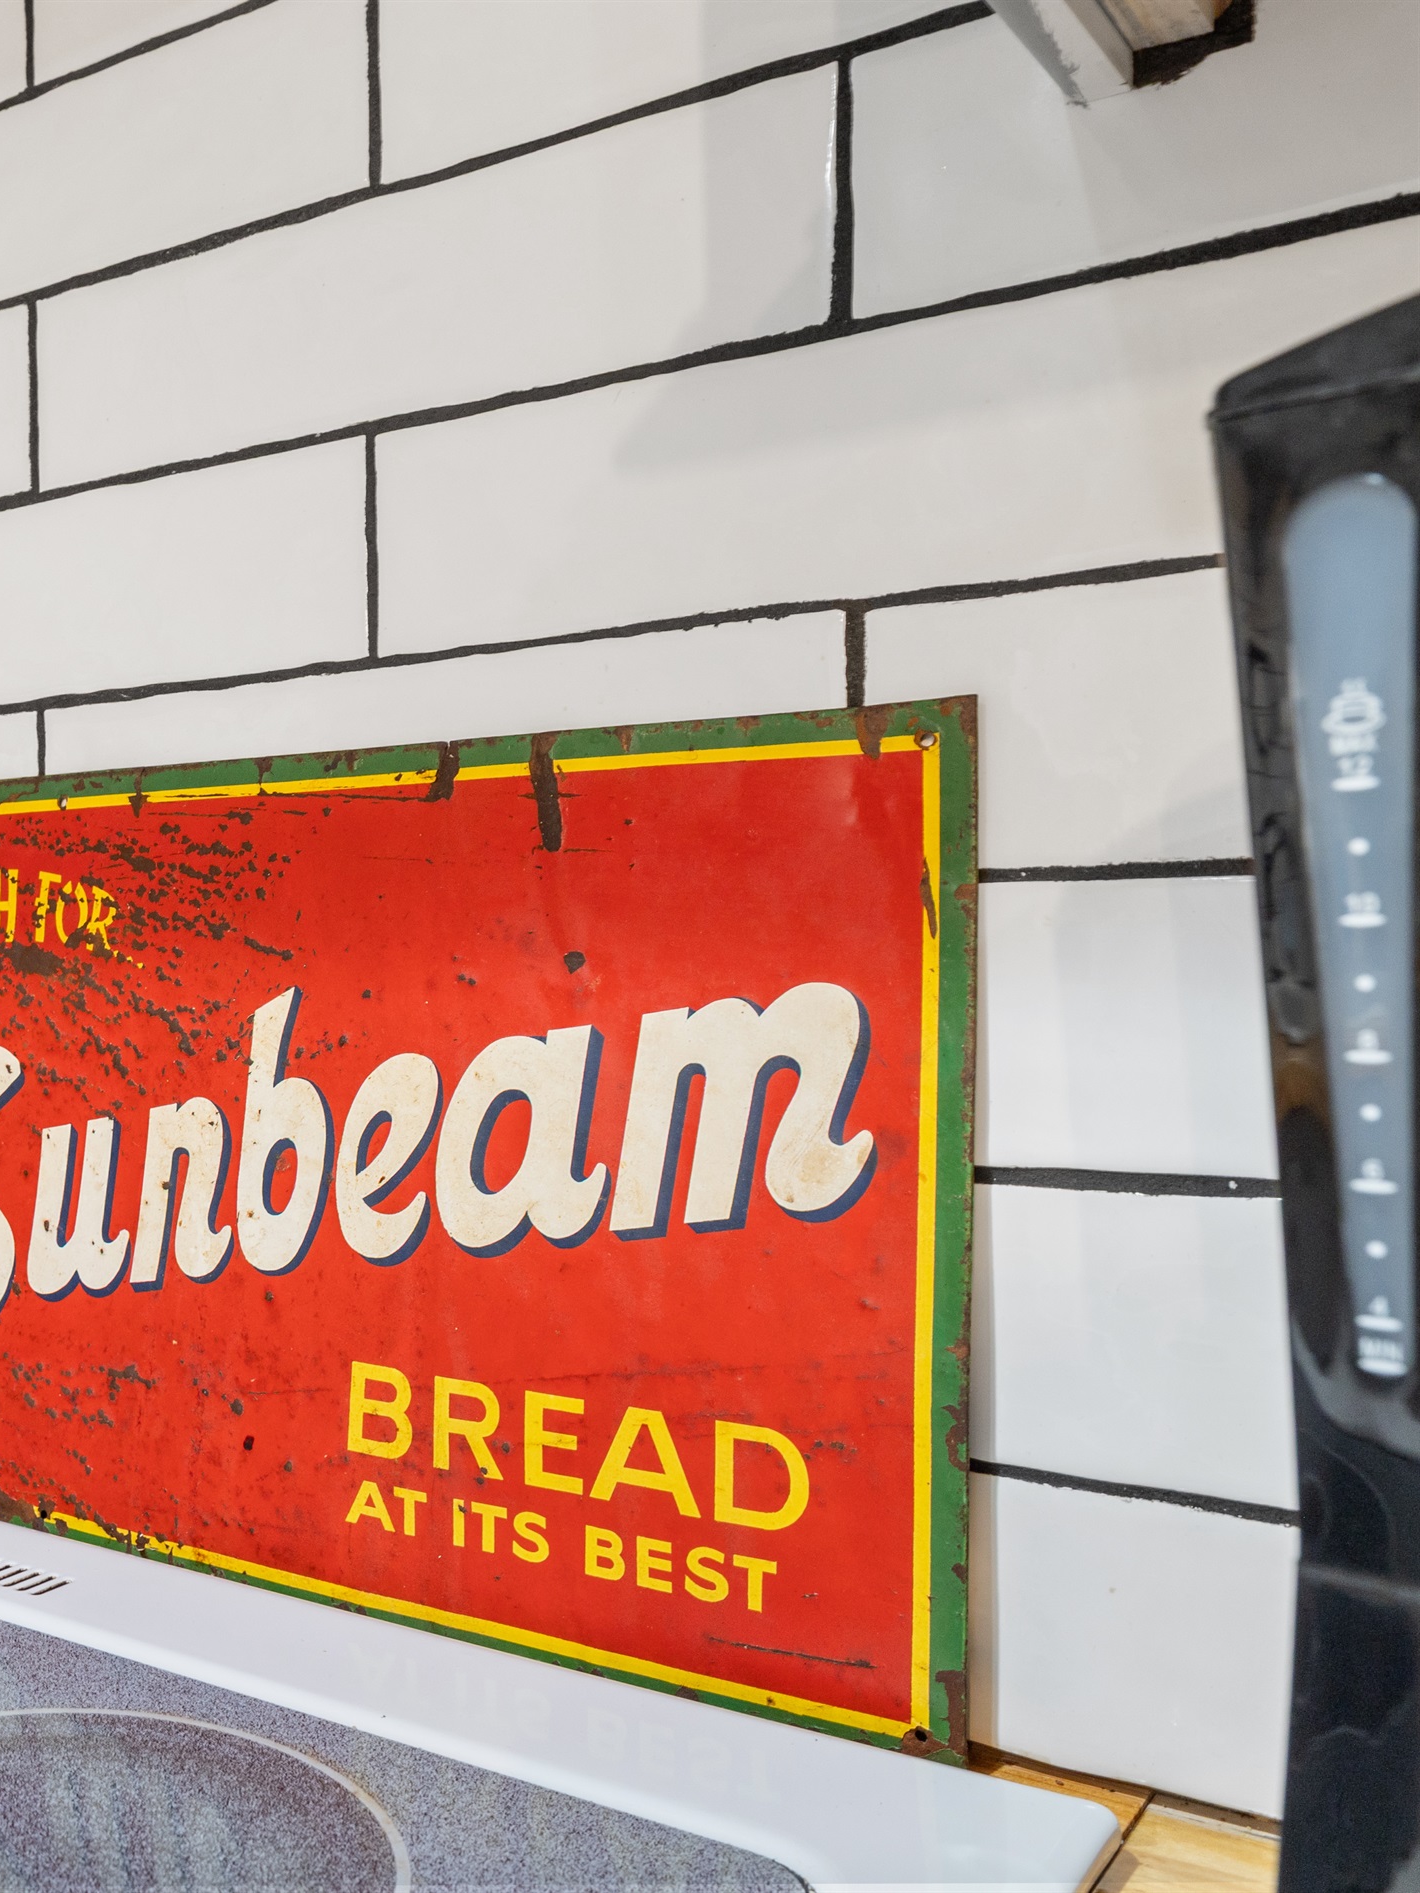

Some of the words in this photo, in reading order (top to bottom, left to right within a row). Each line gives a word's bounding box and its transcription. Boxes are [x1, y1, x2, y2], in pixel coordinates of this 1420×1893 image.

[34, 871, 138, 962] FOR
[347, 1360, 810, 1531] BREAD
[345, 1480, 428, 1537] AT
[452, 1498, 550, 1564] ITS
[584, 1524, 778, 1613] BEST
